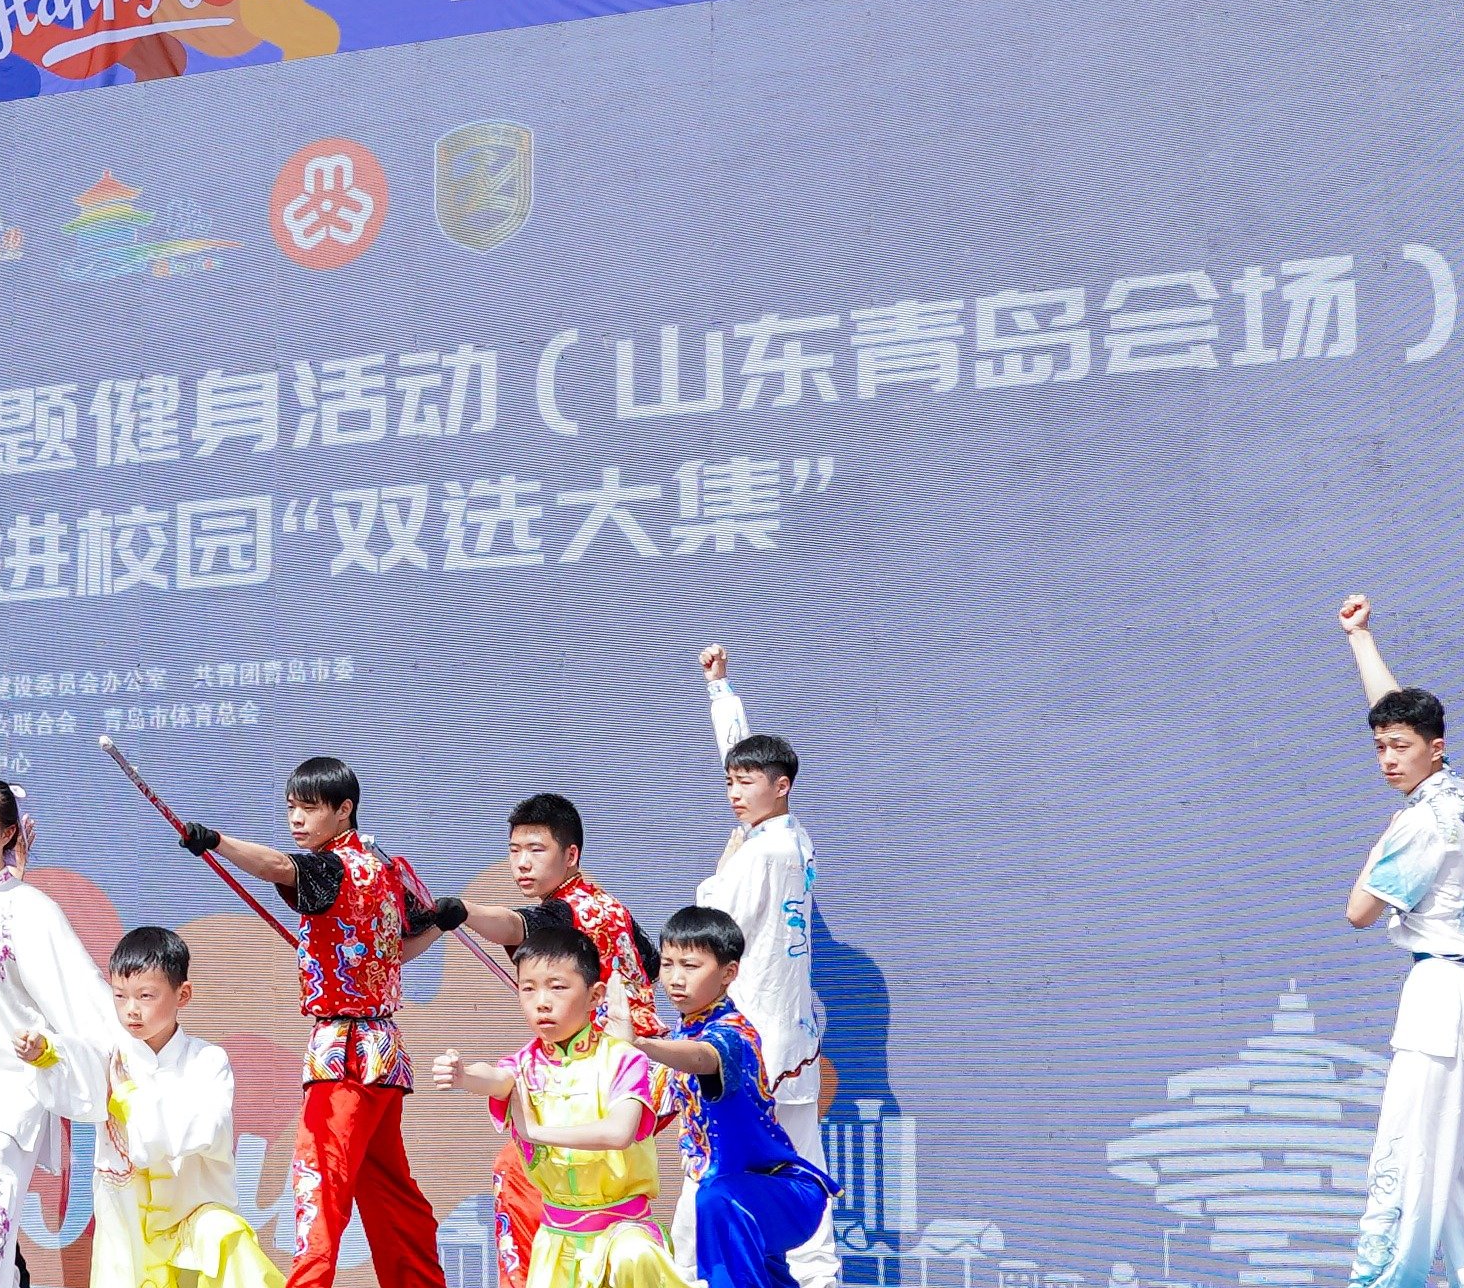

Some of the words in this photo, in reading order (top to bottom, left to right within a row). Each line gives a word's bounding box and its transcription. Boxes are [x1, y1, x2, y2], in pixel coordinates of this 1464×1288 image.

[193, 656, 357, 689] 共青团青岛市委
[103, 699, 262, 733] 青岛市体育总会
